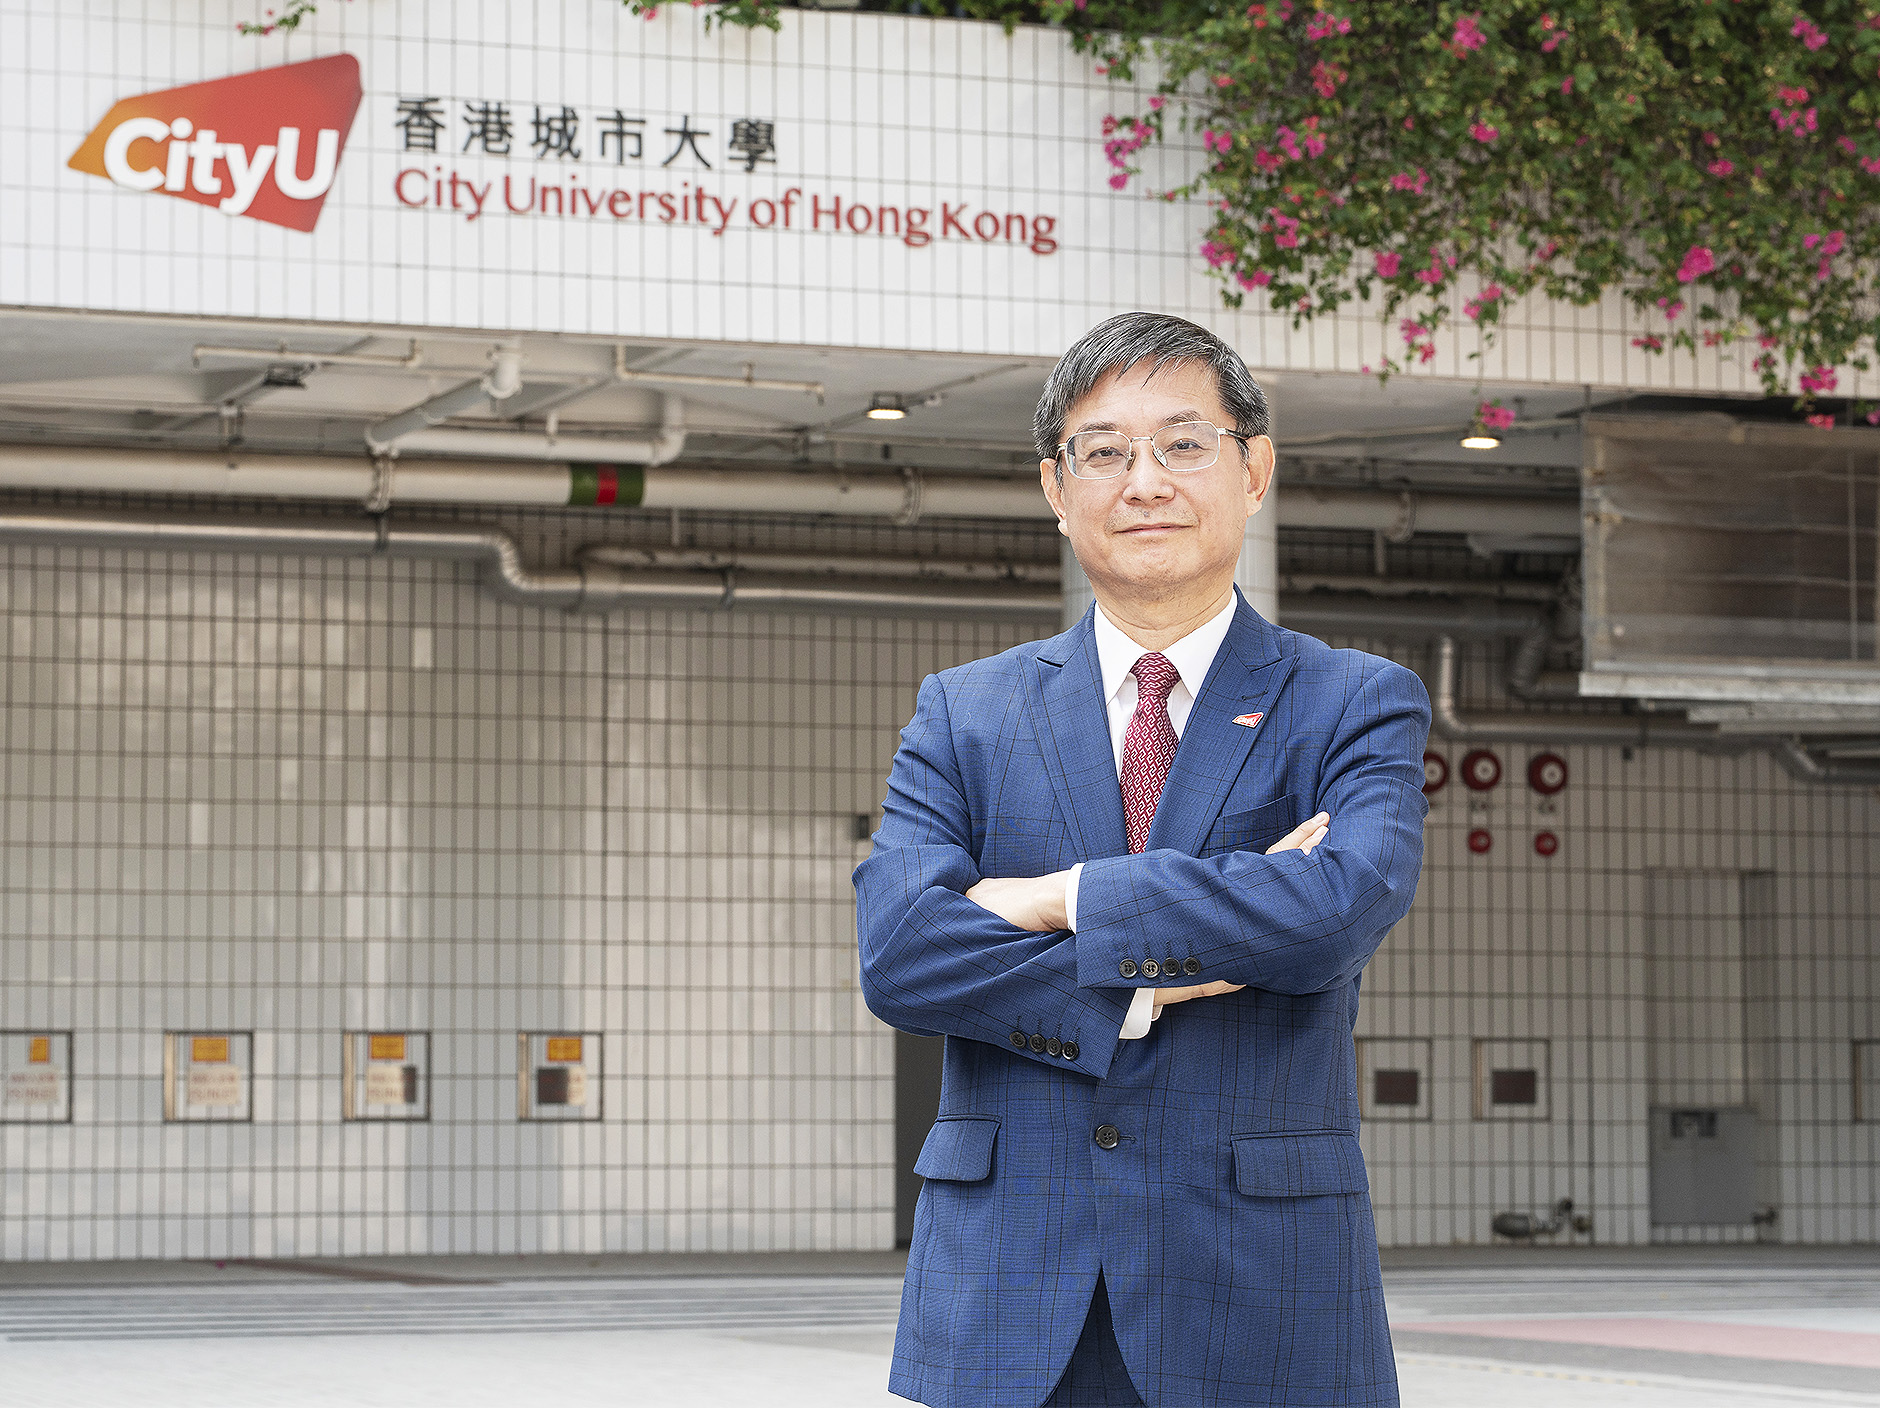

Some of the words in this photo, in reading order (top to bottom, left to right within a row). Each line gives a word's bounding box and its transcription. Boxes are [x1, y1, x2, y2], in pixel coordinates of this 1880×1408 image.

[104, 117, 339, 215] CityU
[396, 97, 776, 173] 香港城市大學
[395, 166, 491, 220] City
[504, 174, 736, 236] University
[750, 187, 802, 229] of
[812, 194, 931, 247] Hong
[942, 202, 1057, 254] Kong
